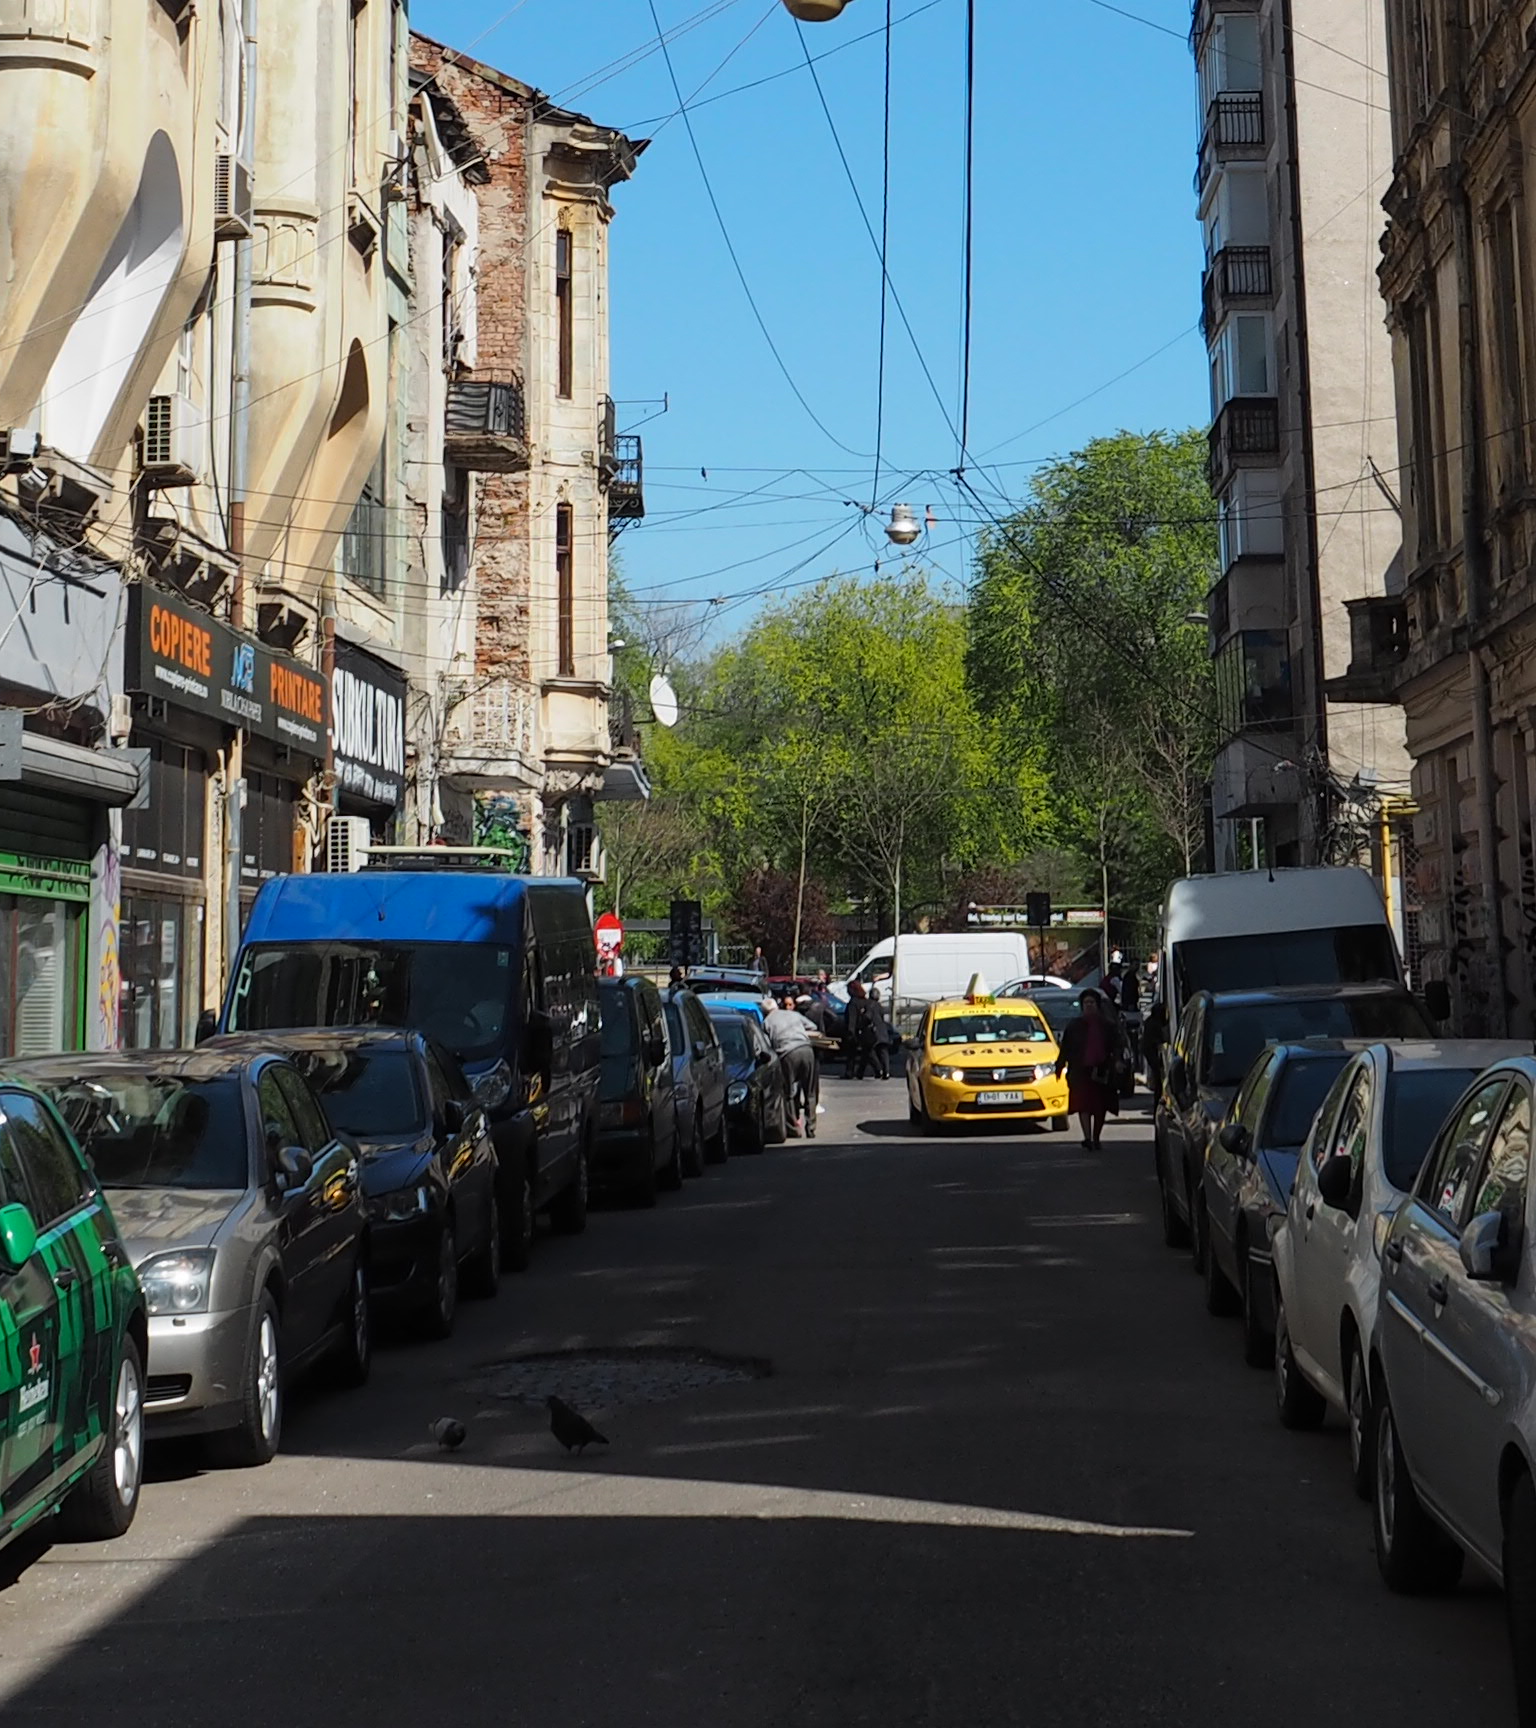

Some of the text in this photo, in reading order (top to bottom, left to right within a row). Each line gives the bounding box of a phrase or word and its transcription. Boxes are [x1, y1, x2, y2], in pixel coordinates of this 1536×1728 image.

[150, 604, 211, 677] COPIERE
[270, 662, 322, 724] PRINTARE
[331, 666, 404, 776] SUBKULTURA
